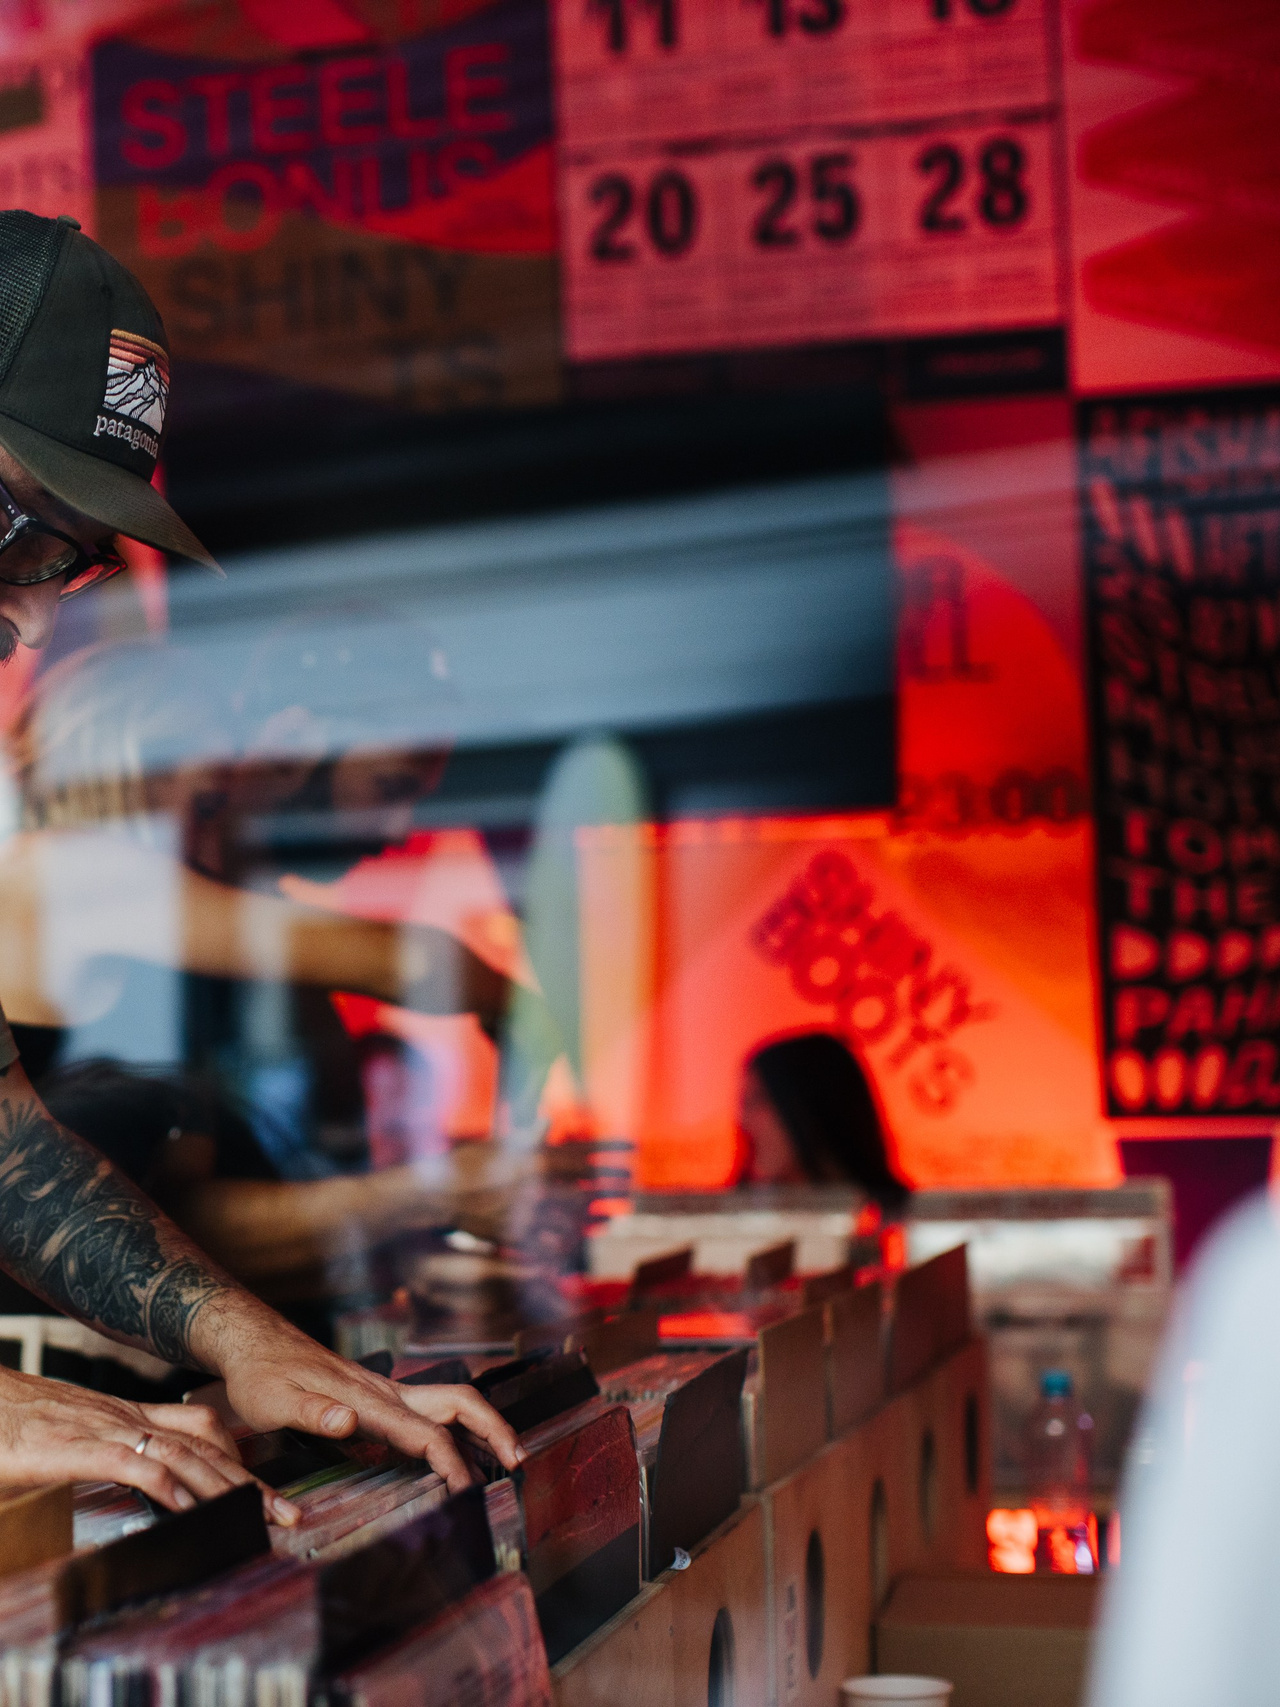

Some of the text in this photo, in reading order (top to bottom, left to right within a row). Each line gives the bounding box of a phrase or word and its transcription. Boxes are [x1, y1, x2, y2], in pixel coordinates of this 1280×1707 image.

[121, 43, 512, 170] STEELE
[587, 136, 1029, 266] 20 25 28
[166, 247, 474, 344] SHINY
[92, 414, 160, 460] patagonia
